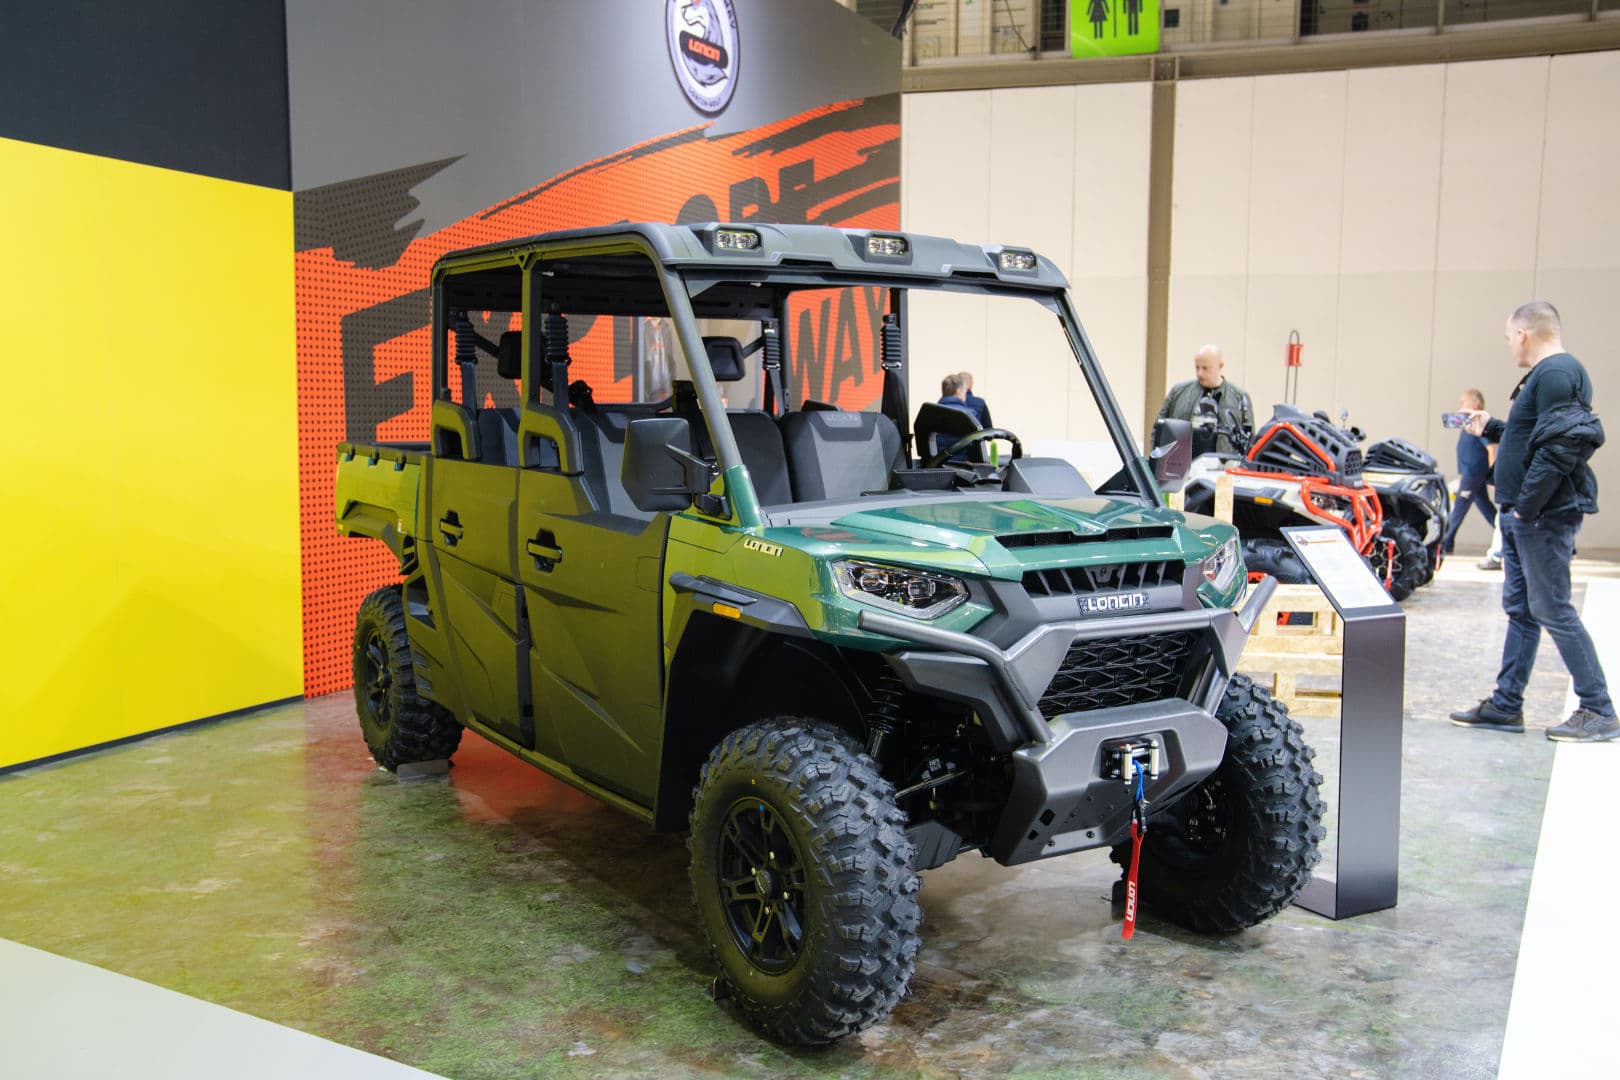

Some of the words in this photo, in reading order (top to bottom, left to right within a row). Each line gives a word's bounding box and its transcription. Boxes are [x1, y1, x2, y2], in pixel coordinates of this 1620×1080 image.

[743, 539, 783, 557] LONCIN
[1087, 593, 1144, 611] LONCIN
[1126, 881, 1136, 922] LONCIN
